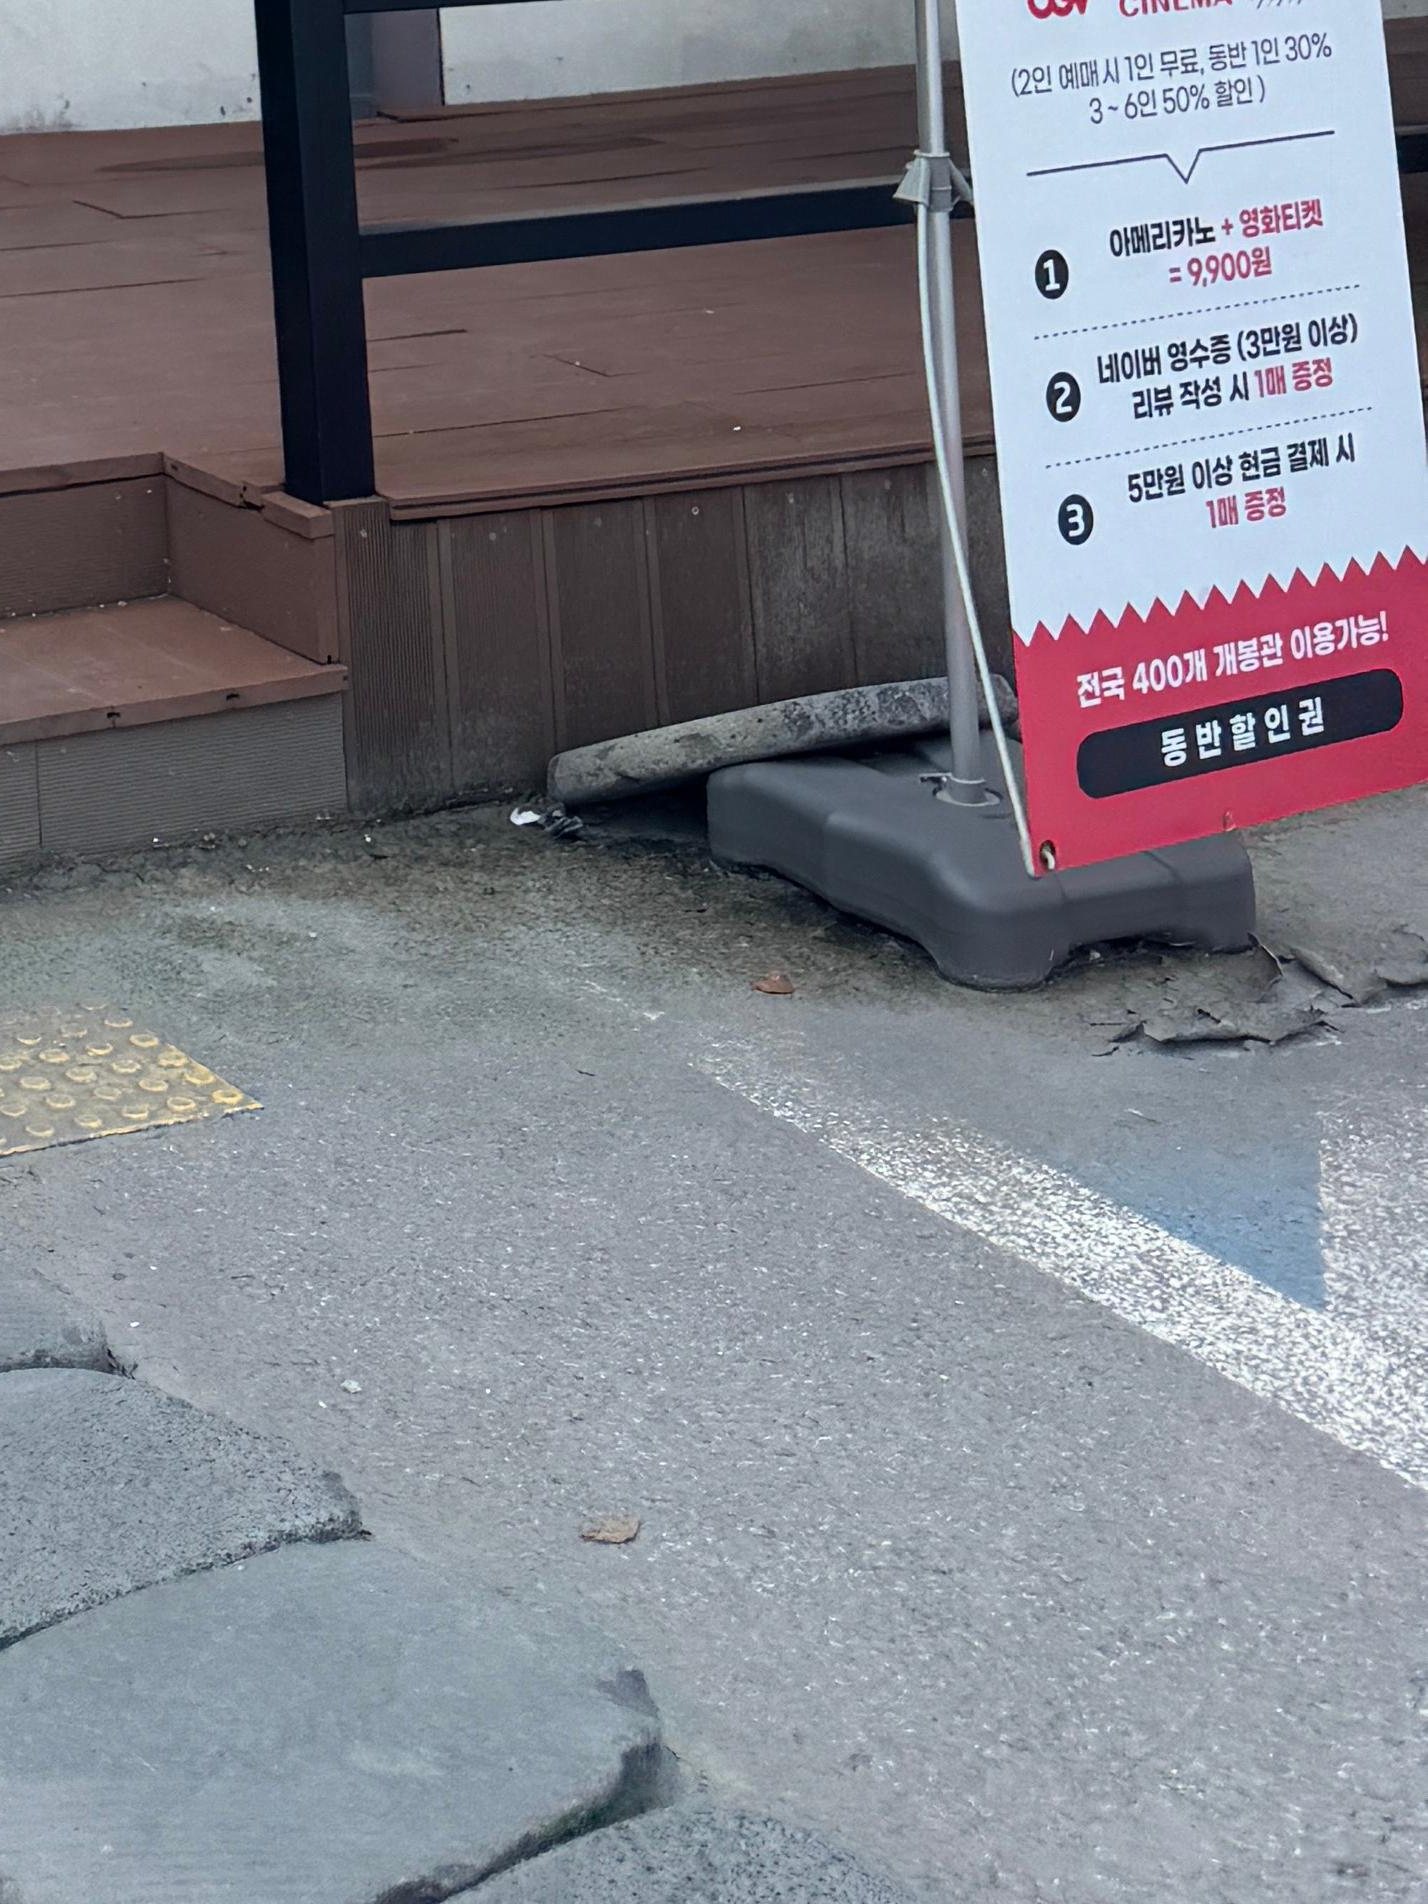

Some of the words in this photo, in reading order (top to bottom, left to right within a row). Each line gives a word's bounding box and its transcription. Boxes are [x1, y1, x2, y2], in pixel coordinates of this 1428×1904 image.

[1011, 66, 1053, 98] (2인
[1058, 60, 1100, 91] 예매
[1102, 57, 1121, 86] 시
[1123, 53, 1155, 82] 1인
[1159, 47, 1205, 77] 무료,
[1208, 41, 1247, 70] 동반
[1250, 36, 1281, 65] 1인
[1284, 31, 1333, 62] 30%
[1162, 84, 1210, 115] 50%
[1108, 216, 1217, 258] 아메리카노
[1238, 197, 1325, 239] 영화티켓
[1186, 245, 1273, 288] 9,900원
[1096, 346, 1162, 385] 네이버
[1167, 334, 1232, 373] 영수증
[1236, 321, 1303, 363] (3만원
[1307, 312, 1359, 347] 이상)
[1132, 386, 1174, 420] 리뷰
[1179, 376, 1223, 412] 작성
[1229, 371, 1249, 403] 시
[1254, 365, 1287, 398] 1매
[1291, 357, 1334, 392] 증정
[1127, 464, 1186, 504] 5만원
[1191, 455, 1233, 490] 이상
[1238, 446, 1282, 482] 현금
[1286, 437, 1330, 473] 결제
[1335, 432, 1356, 464] 시
[1205, 496, 1239, 529] 1매
[1243, 487, 1287, 522] 증정
[1076, 667, 1125, 709] 전국
[1132, 648, 1208, 694] 400개
[1213, 632, 1284, 678] 개봉관
[1289, 610, 1389, 661] 이용가능!
